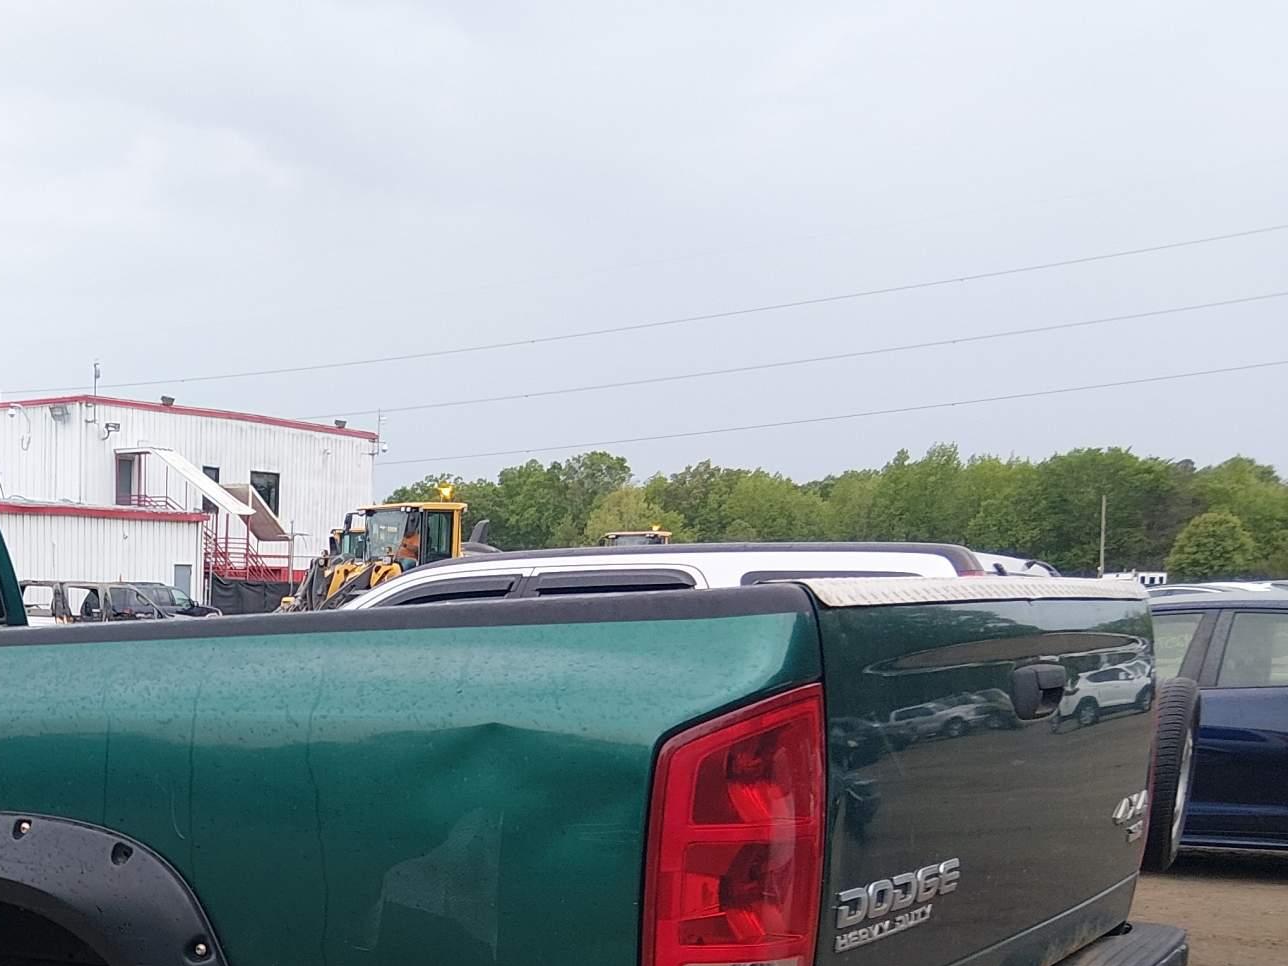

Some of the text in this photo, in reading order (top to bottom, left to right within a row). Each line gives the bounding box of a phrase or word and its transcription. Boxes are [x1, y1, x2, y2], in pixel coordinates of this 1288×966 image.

[836, 857, 961, 929] DODGE
[835, 904, 933, 953] HEAVY DUTY
